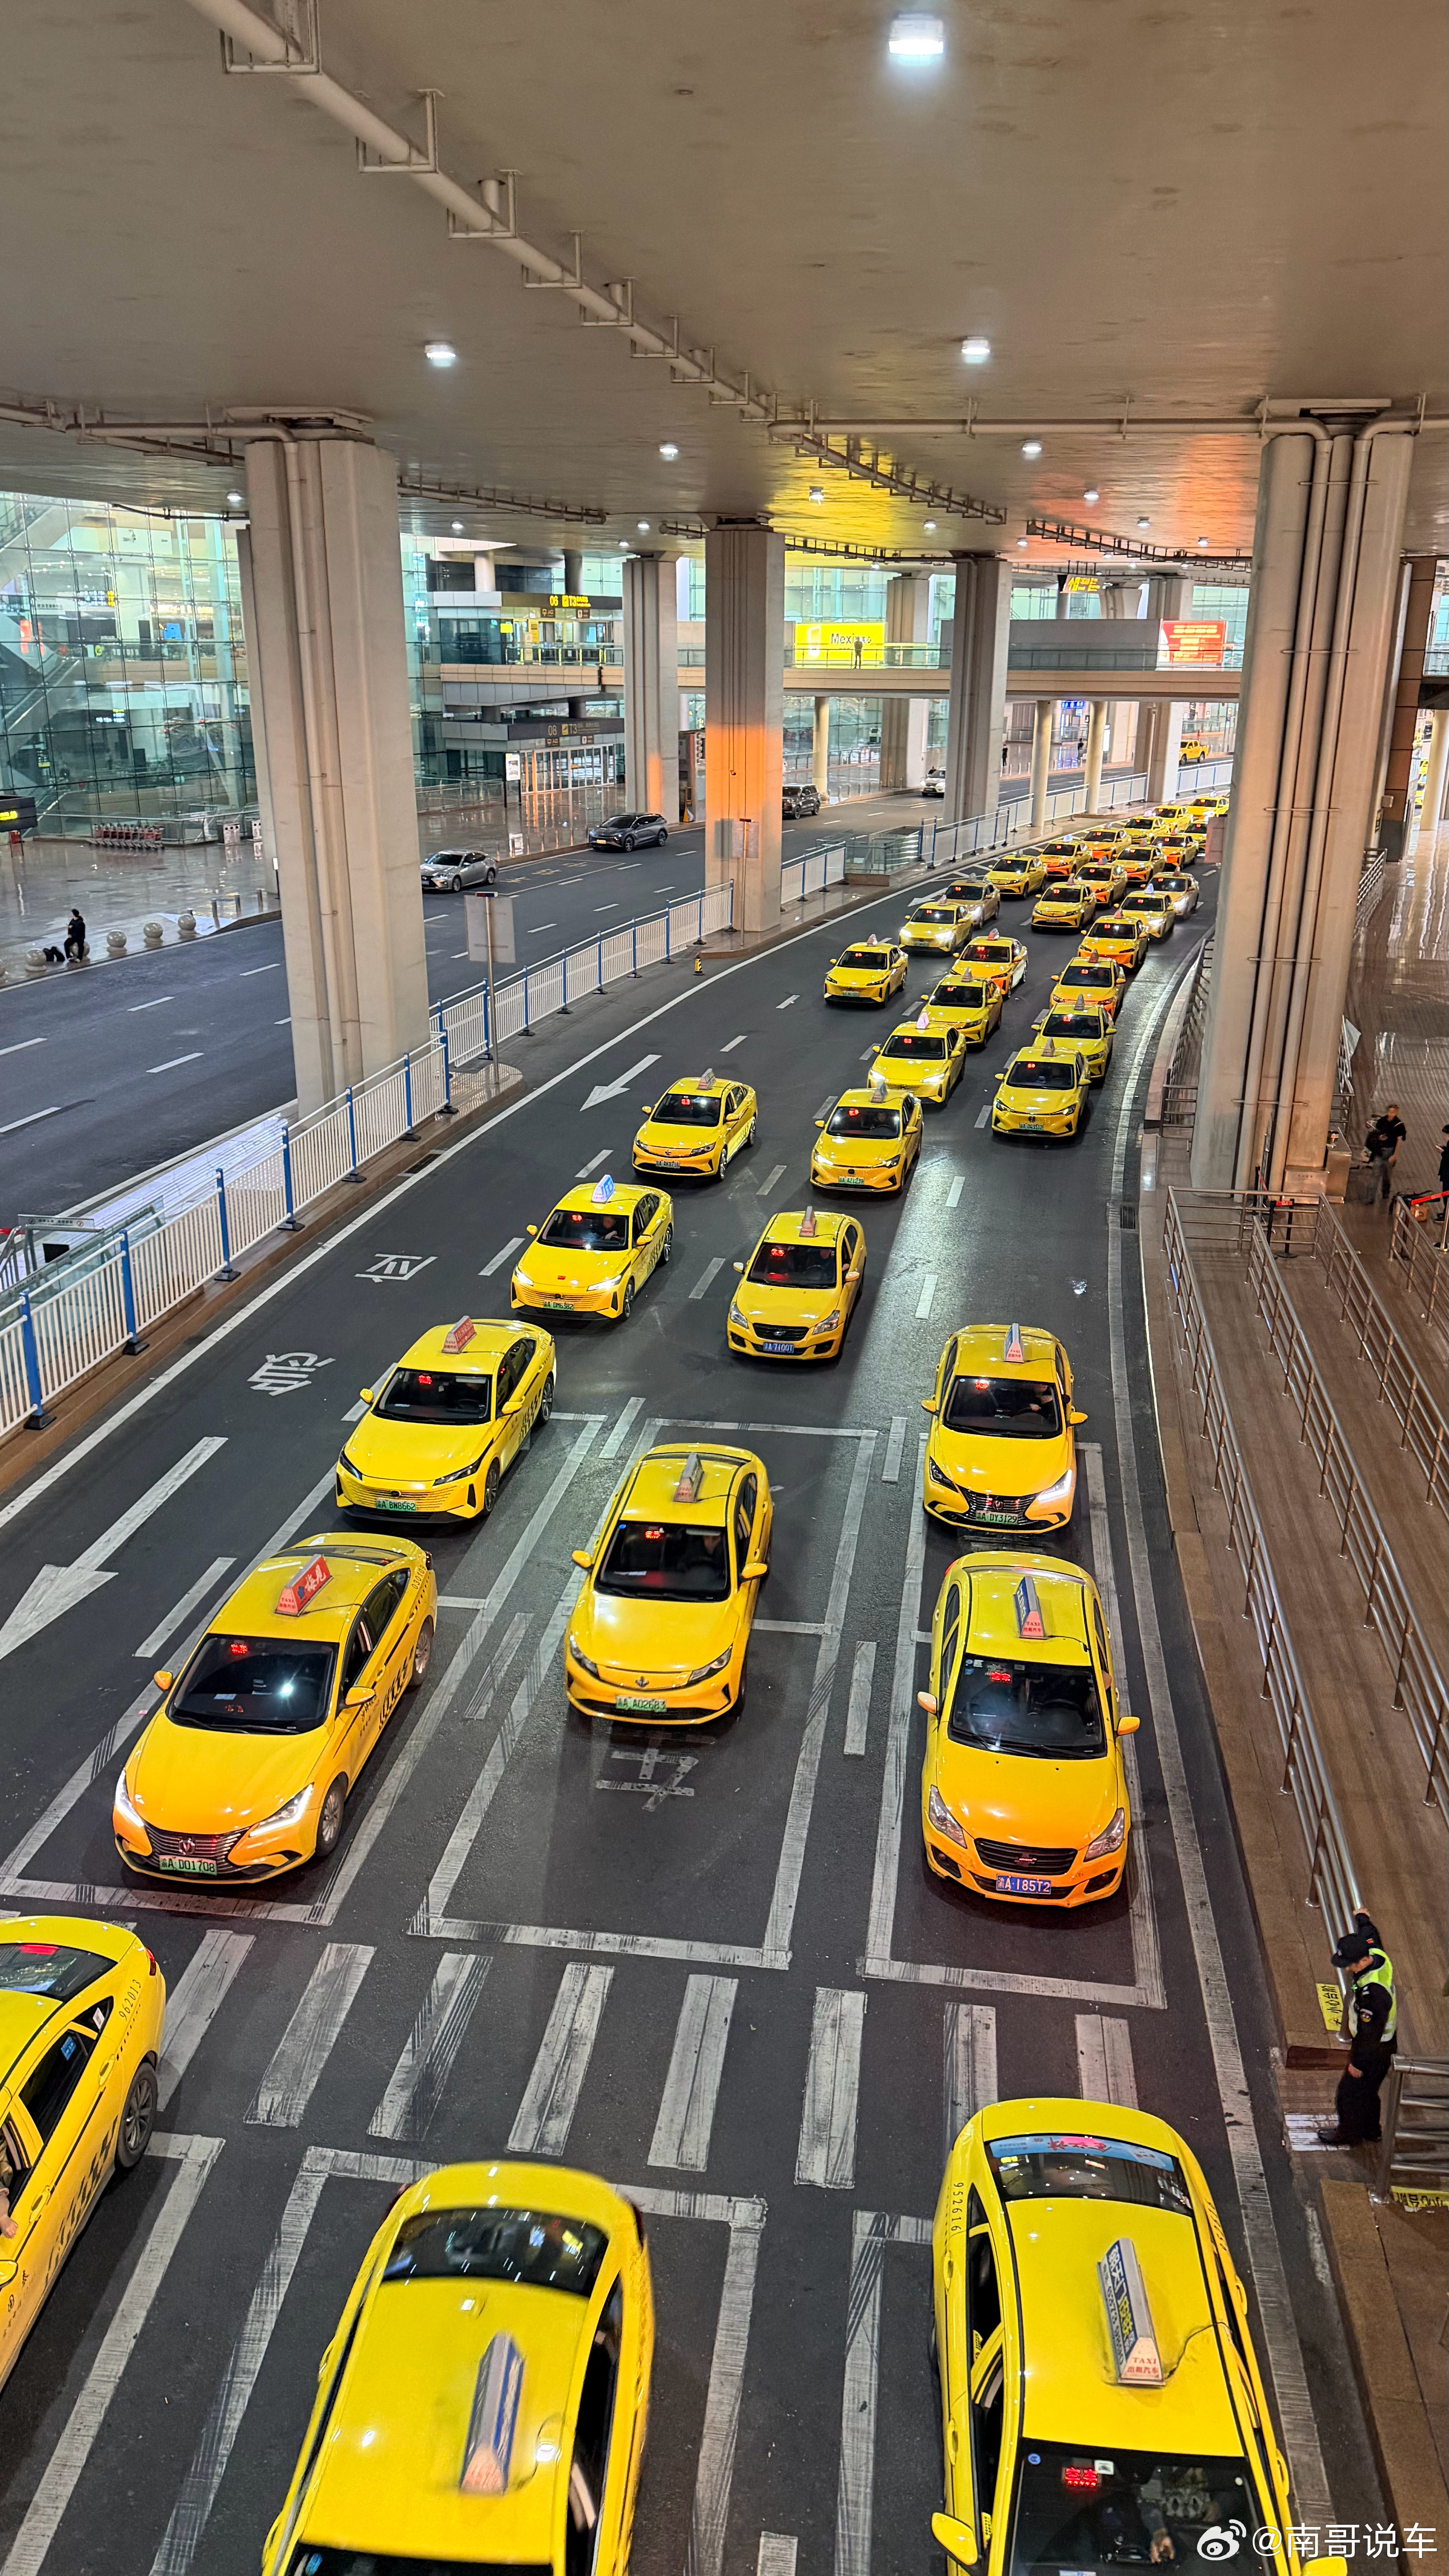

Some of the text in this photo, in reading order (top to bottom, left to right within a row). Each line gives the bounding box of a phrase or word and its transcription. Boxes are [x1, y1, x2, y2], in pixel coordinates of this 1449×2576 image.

[550, 595, 558, 607] 06
[568, 595, 577, 607] T3
[548, 725, 557, 736] 08
[568, 724, 577, 734] T3
[118, 1978, 141, 2019] 962013
[1321, 1985, 1343, 2014] 小心台阶
[951, 2182, 964, 2231] 952616
[1127, 2366, 1159, 2374] 出租汽车
